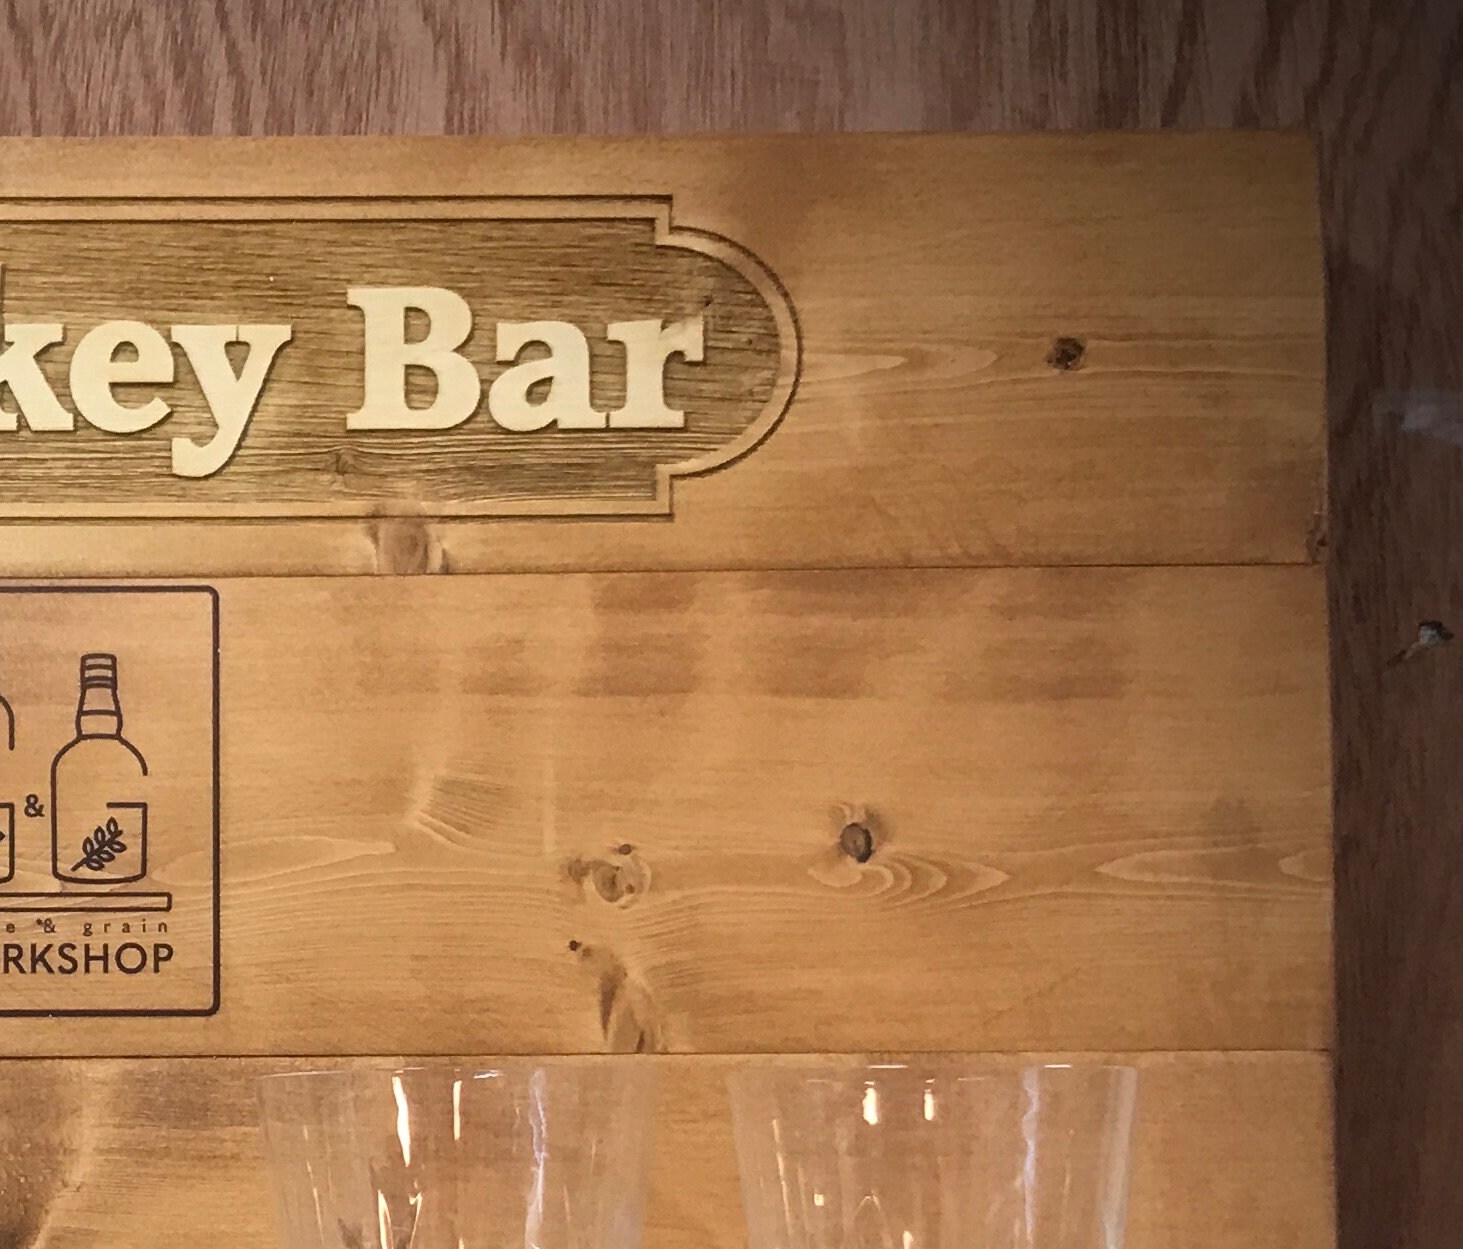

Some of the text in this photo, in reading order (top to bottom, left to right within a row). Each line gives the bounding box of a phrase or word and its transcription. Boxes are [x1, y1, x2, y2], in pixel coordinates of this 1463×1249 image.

[345, 285, 705, 435] Bar
[23, 793, 44, 817] &
[82, 918, 168, 937] grain
